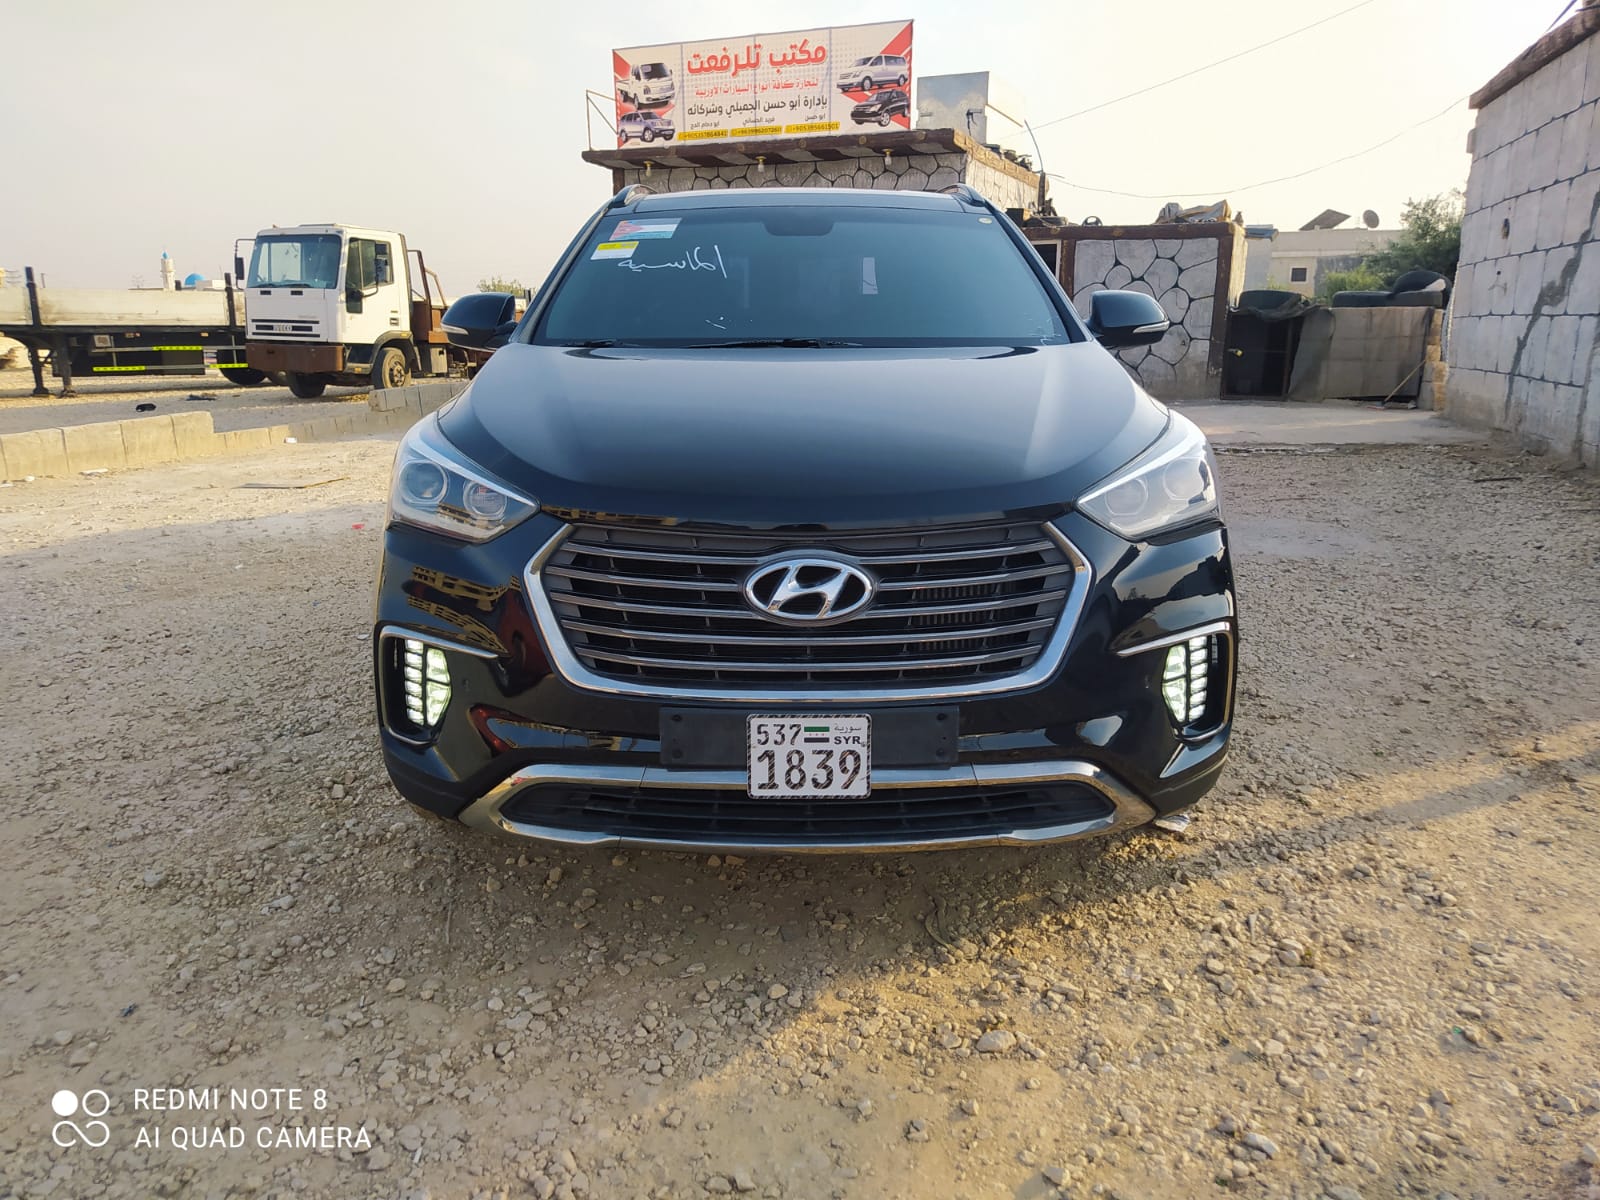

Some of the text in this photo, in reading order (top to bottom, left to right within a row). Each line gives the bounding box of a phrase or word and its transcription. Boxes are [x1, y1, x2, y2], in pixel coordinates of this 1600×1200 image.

[687, 38, 827, 77] مكتب تلرفعت
[763, 100, 786, 112] حسن
[757, 723, 802, 746] 537
[834, 723, 861, 734] سورية
[834, 735, 861, 745] SYR
[757, 749, 861, 790] 1839
